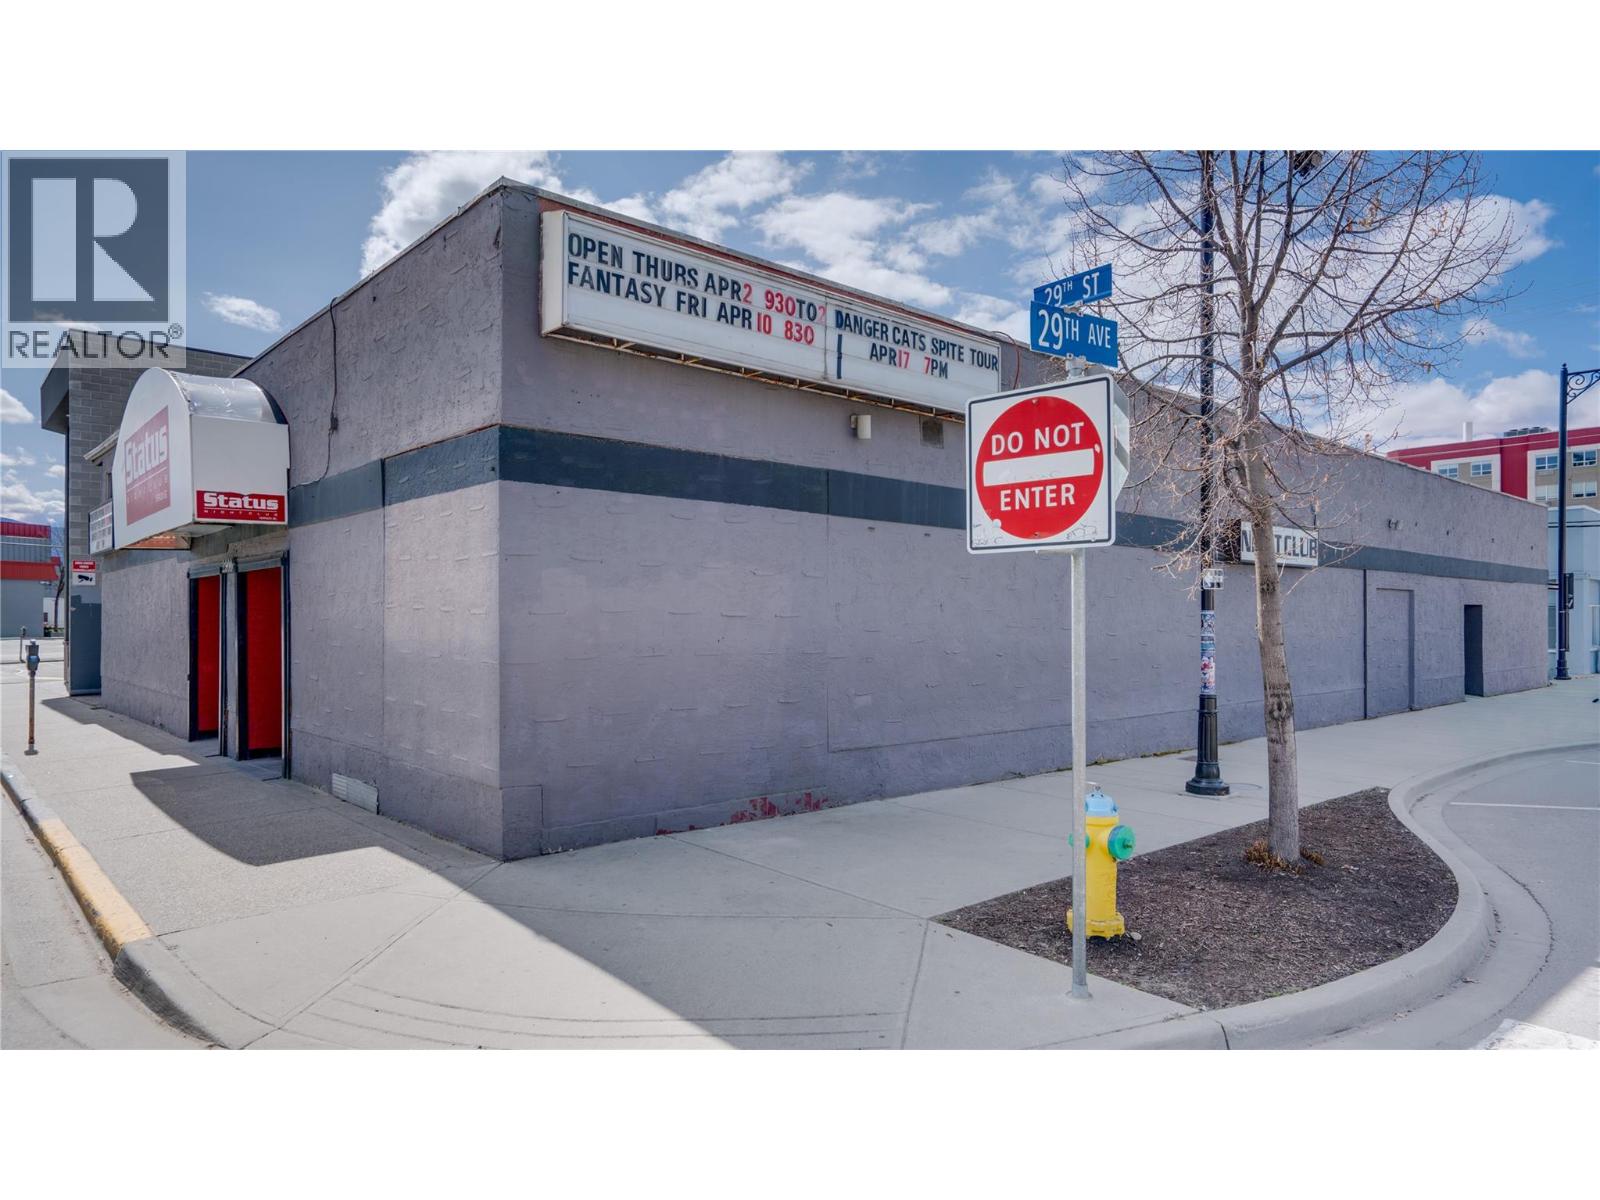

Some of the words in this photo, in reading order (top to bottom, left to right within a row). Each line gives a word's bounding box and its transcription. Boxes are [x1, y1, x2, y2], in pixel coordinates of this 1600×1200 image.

[567, 232, 623, 269] OPEN
[632, 251, 699, 289] THURS
[567, 261, 666, 308] FANTASY
[676, 290, 707, 318] FRI
[784, 320, 815, 346] 830
[1044, 281, 1073, 307] 29TH
[1082, 272, 1100, 299] ST
[835, 309, 889, 341] DANGER
[892, 326, 926, 351] CATS
[930, 336, 965, 363] SPITE
[969, 347, 999, 372] TOUR
[1038, 309, 1080, 350] 29TH
[1087, 323, 1111, 349] AVE
[924, 356, 949, 379] 7PM
[127, 424, 168, 484] Status
[991, 431, 1024, 456] DO
[1034, 421, 1085, 450] NOT
[203, 492, 279, 510] Status
[1000, 483, 1076, 512] ENTER
[1241, 529, 1318, 558] NTCLUB
